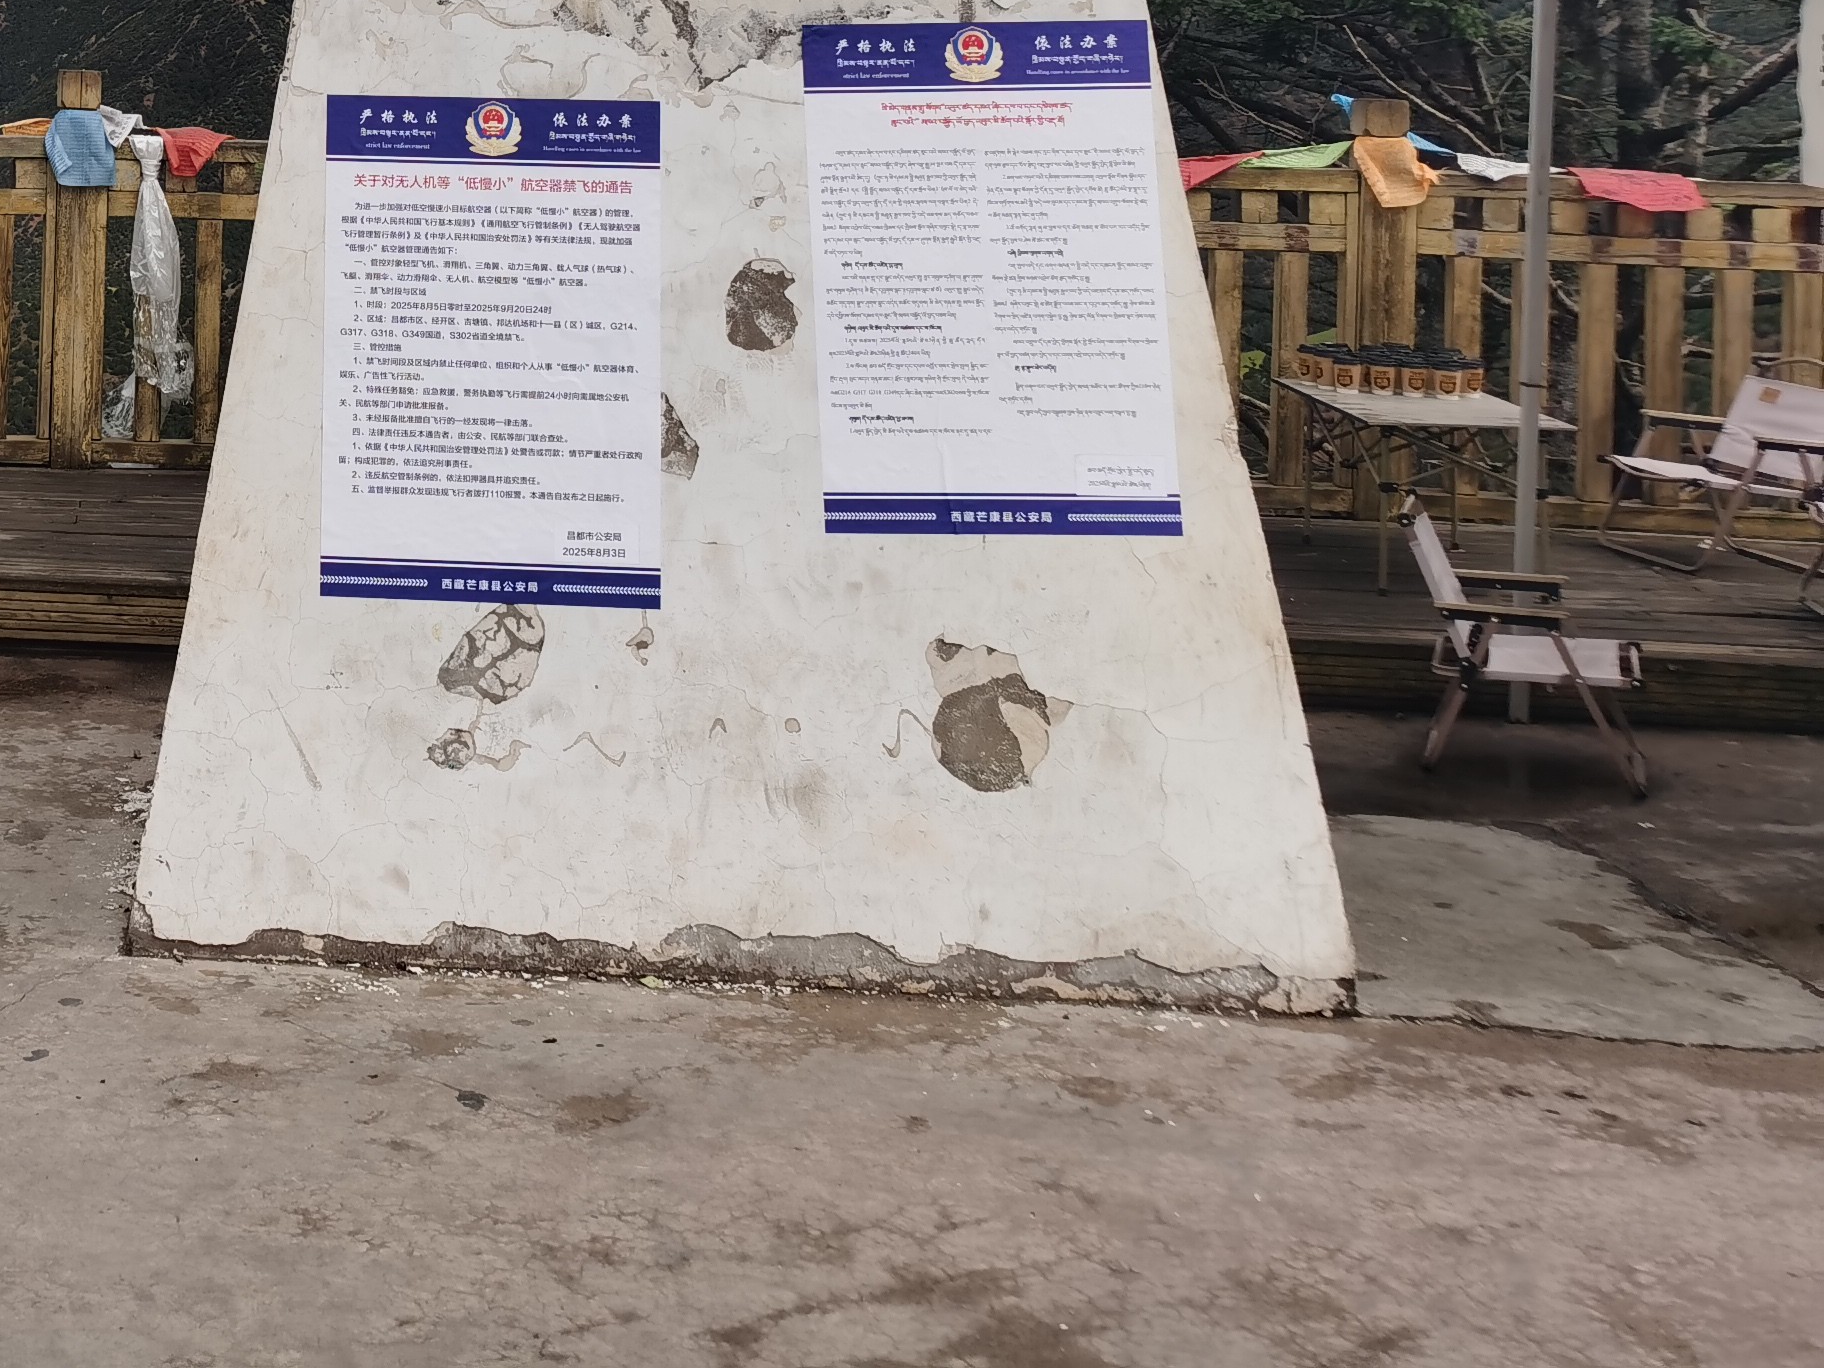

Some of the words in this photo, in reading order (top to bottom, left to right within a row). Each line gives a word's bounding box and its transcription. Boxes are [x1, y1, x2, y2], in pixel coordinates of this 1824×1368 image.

[835, 38, 916, 55] 严格执法
[1034, 33, 1119, 51] 依法办案
[359, 108, 438, 125] 严格执法
[552, 111, 633, 129] 依法办案
[352, 173, 634, 195] 关于对无人机等“低慢小”航空器禁飞的通告
[950, 511, 1053, 524] 西藏芒康县公安局
[565, 530, 622, 542] 昌都市公安局
[561, 546, 626, 559] 2025年8月3日
[441, 578, 539, 593] 西藏芒康县公安局
